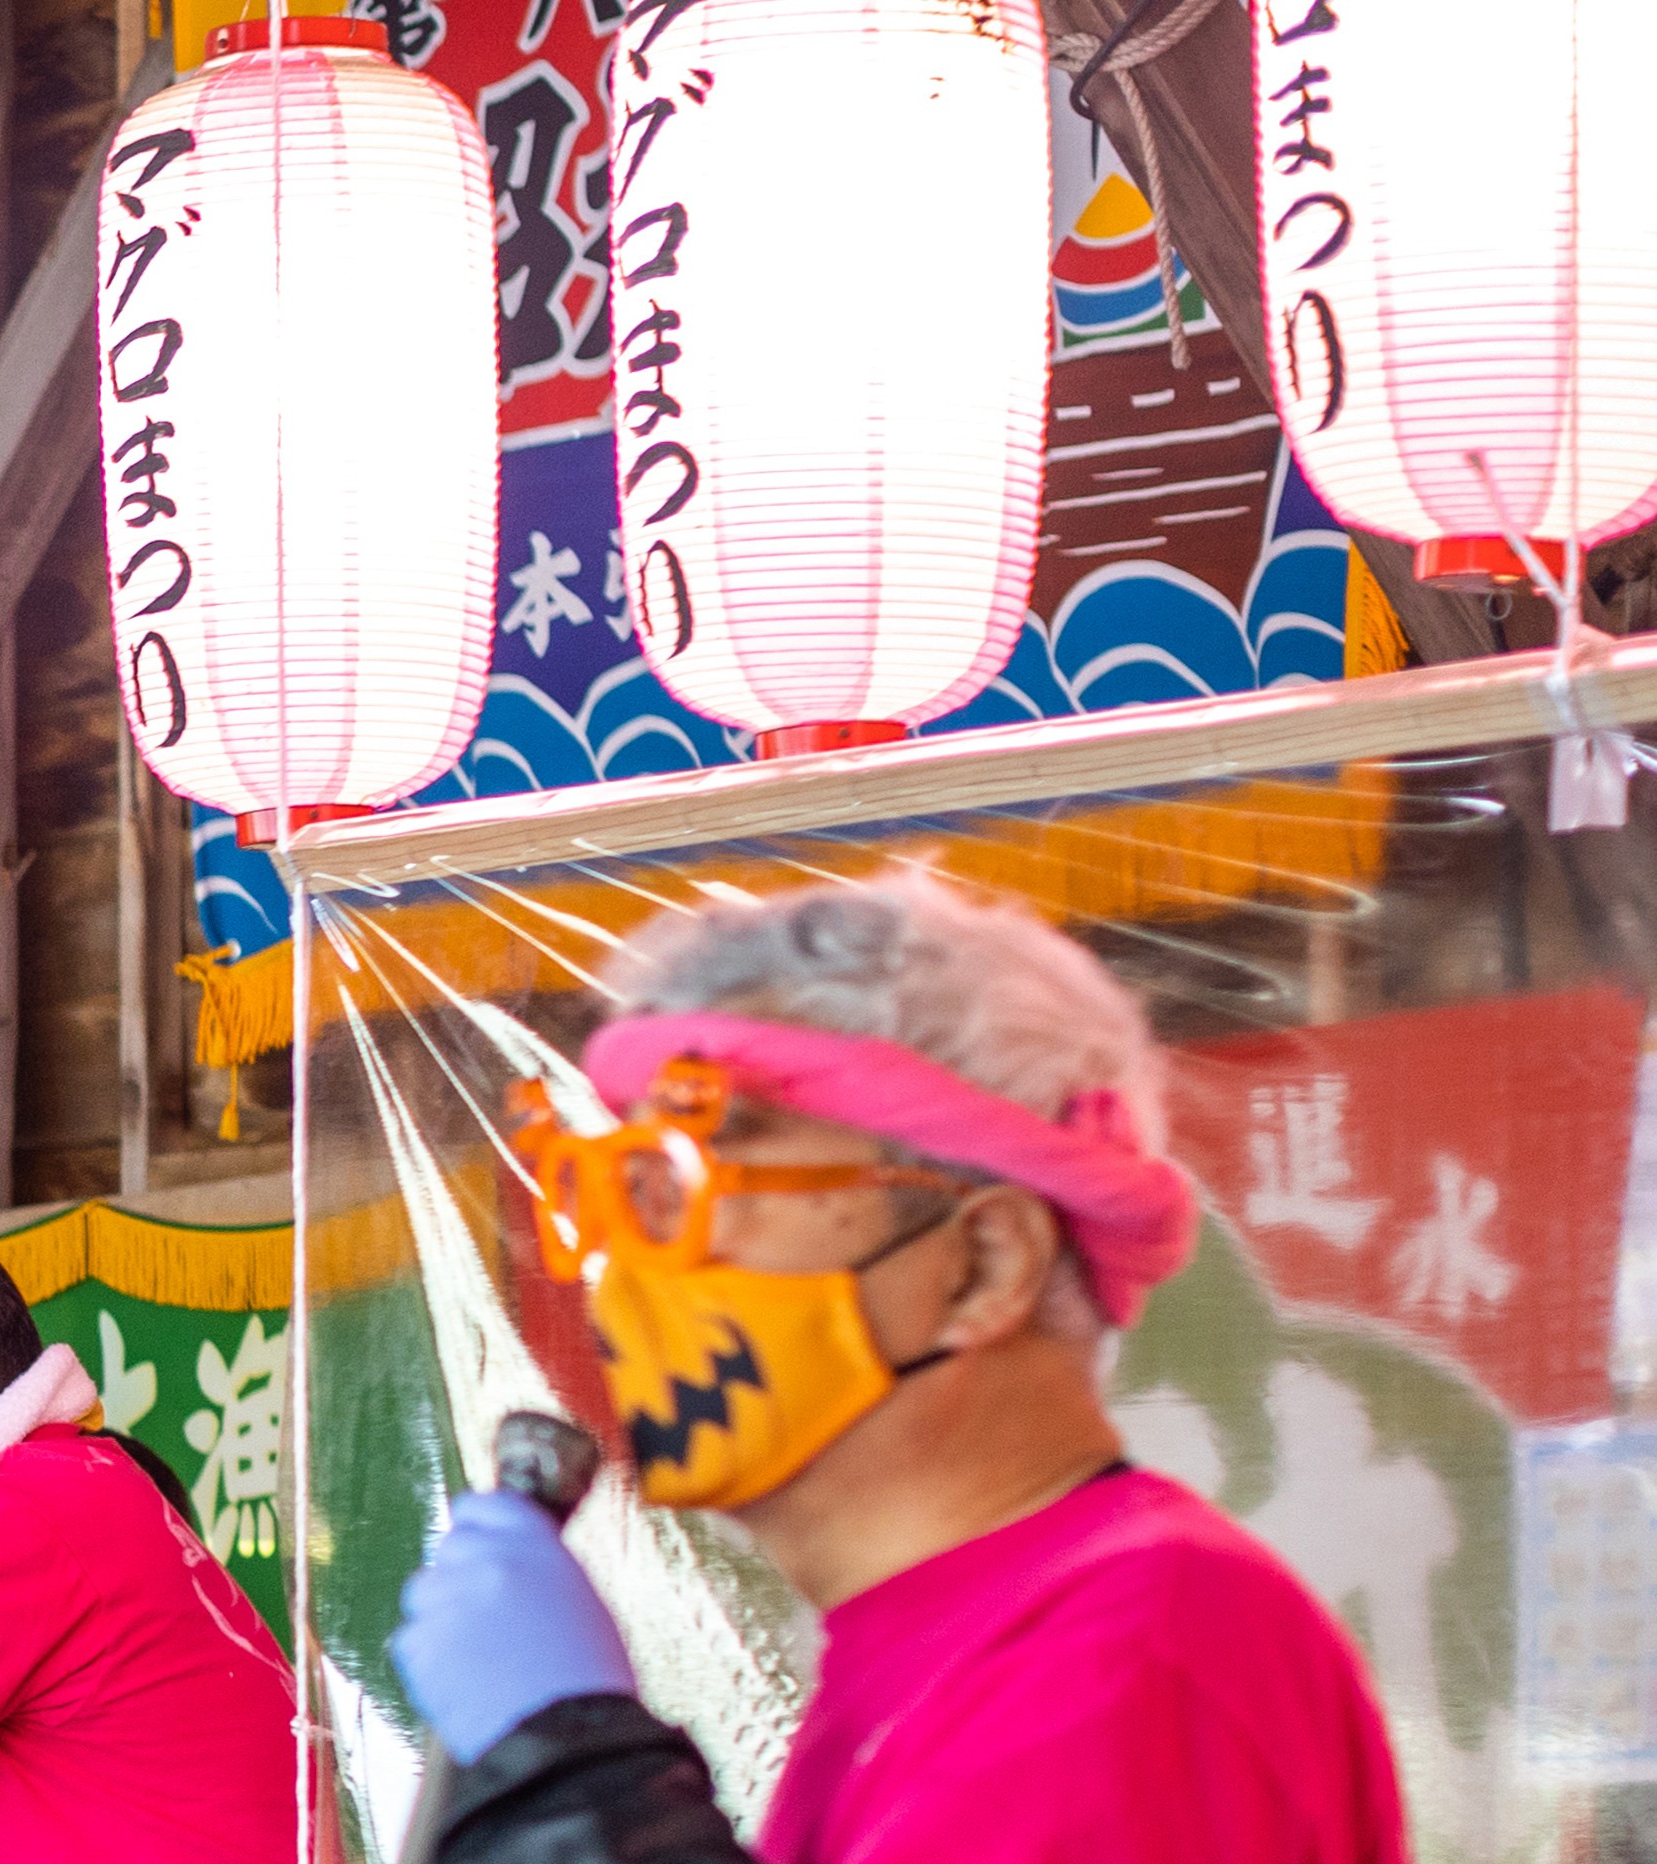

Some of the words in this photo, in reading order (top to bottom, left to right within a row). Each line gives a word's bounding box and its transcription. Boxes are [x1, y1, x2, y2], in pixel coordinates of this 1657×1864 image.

[104, 128, 202, 750] マグロまつり
